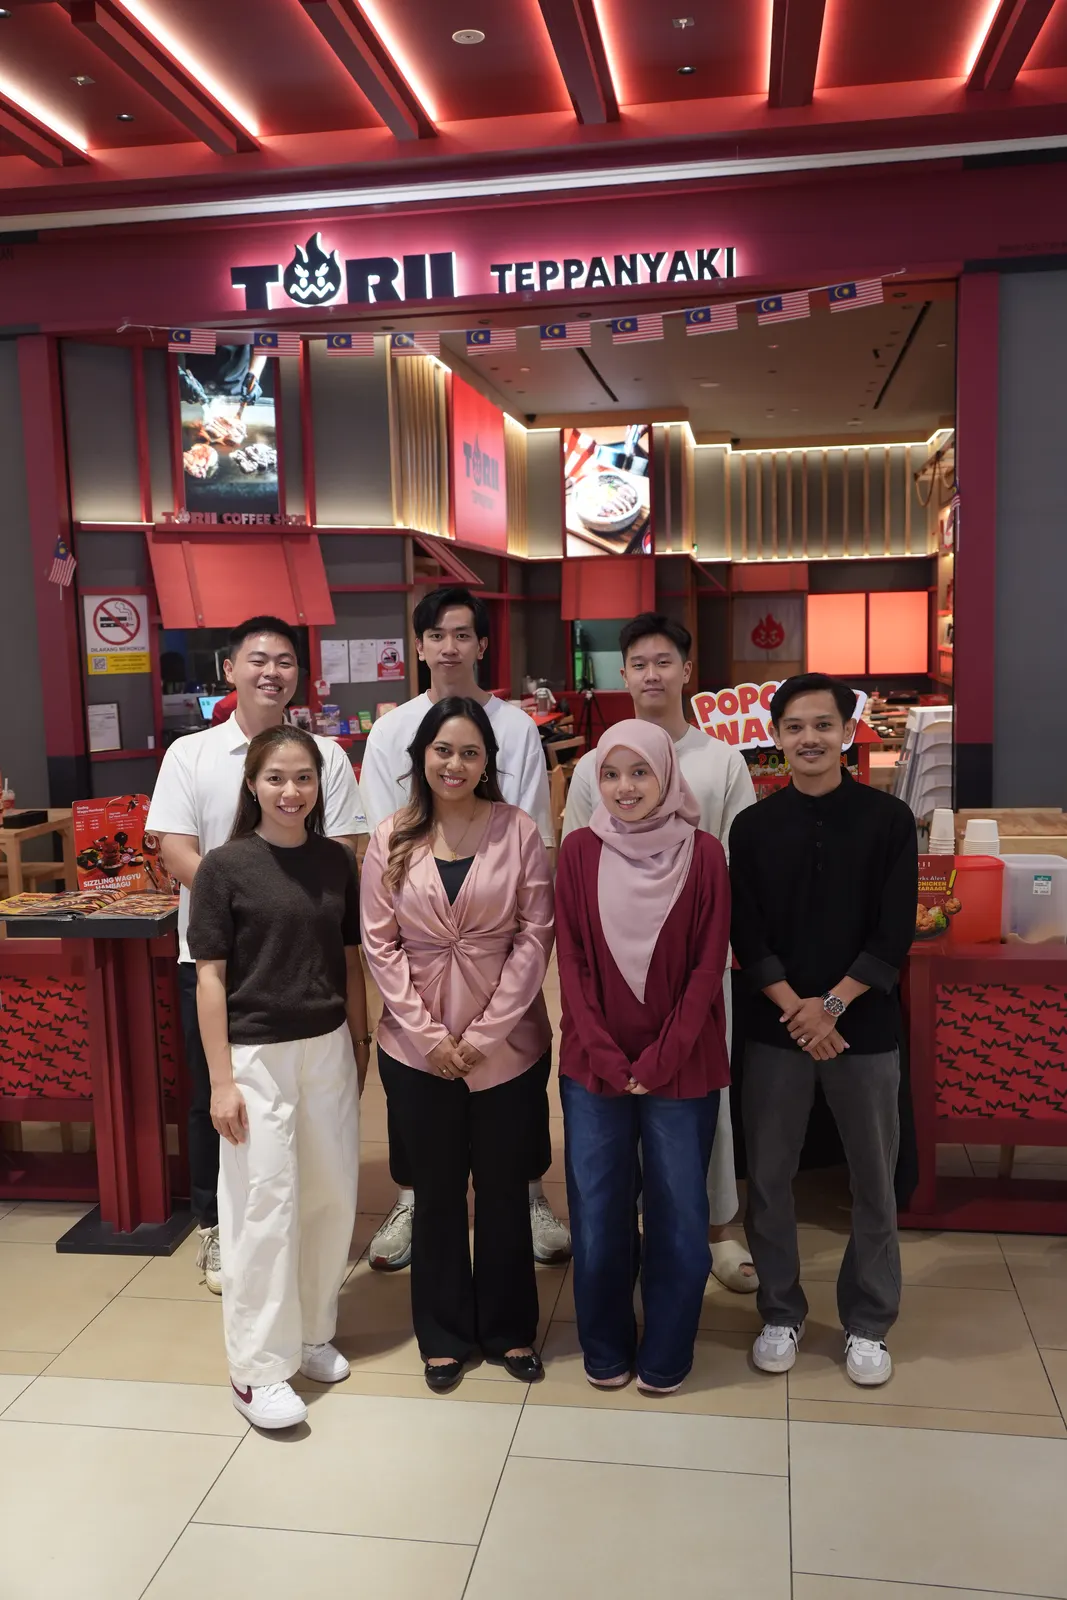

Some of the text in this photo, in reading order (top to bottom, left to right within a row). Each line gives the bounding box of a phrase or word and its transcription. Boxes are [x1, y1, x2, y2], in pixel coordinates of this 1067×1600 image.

[490, 247, 737, 294] TEPPANYAKI
[222, 512, 272, 525] COFFEE
[83, 873, 141, 888] SIZZLING WAGYU
